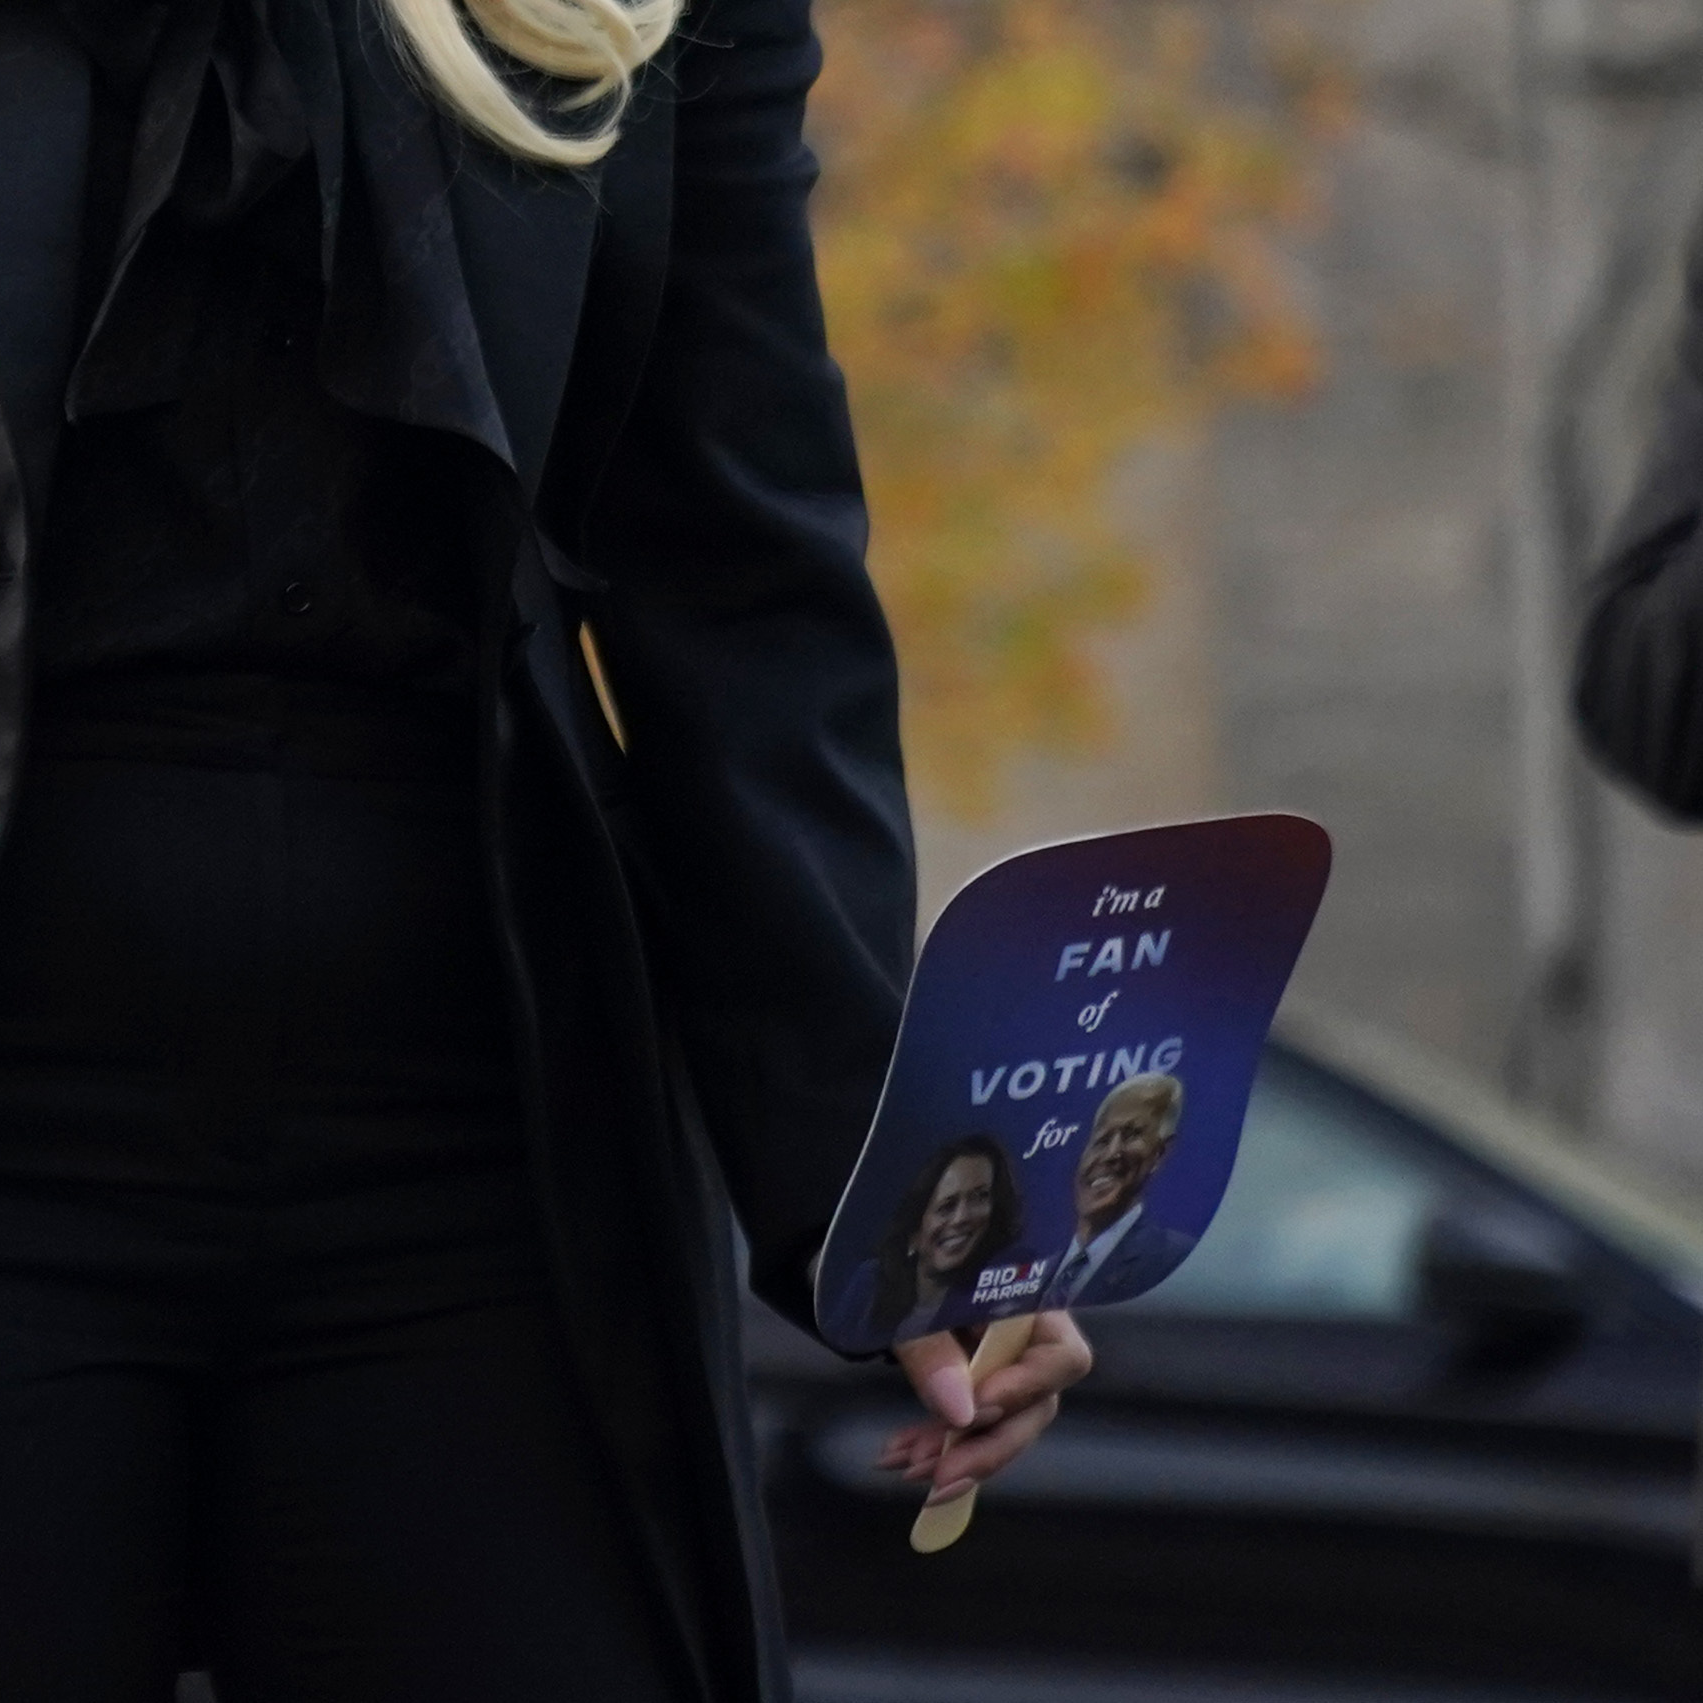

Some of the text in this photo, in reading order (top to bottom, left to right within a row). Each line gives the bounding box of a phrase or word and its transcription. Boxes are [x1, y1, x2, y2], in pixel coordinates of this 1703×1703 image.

[1143, 884, 1165, 909] a
[1053, 930, 1171, 982] FAN
[1077, 991, 1120, 1032] of
[969, 1037, 1184, 1106] VOTING
[1022, 1119, 1079, 1159] for
[972, 1280, 1040, 1304] HARRIS
